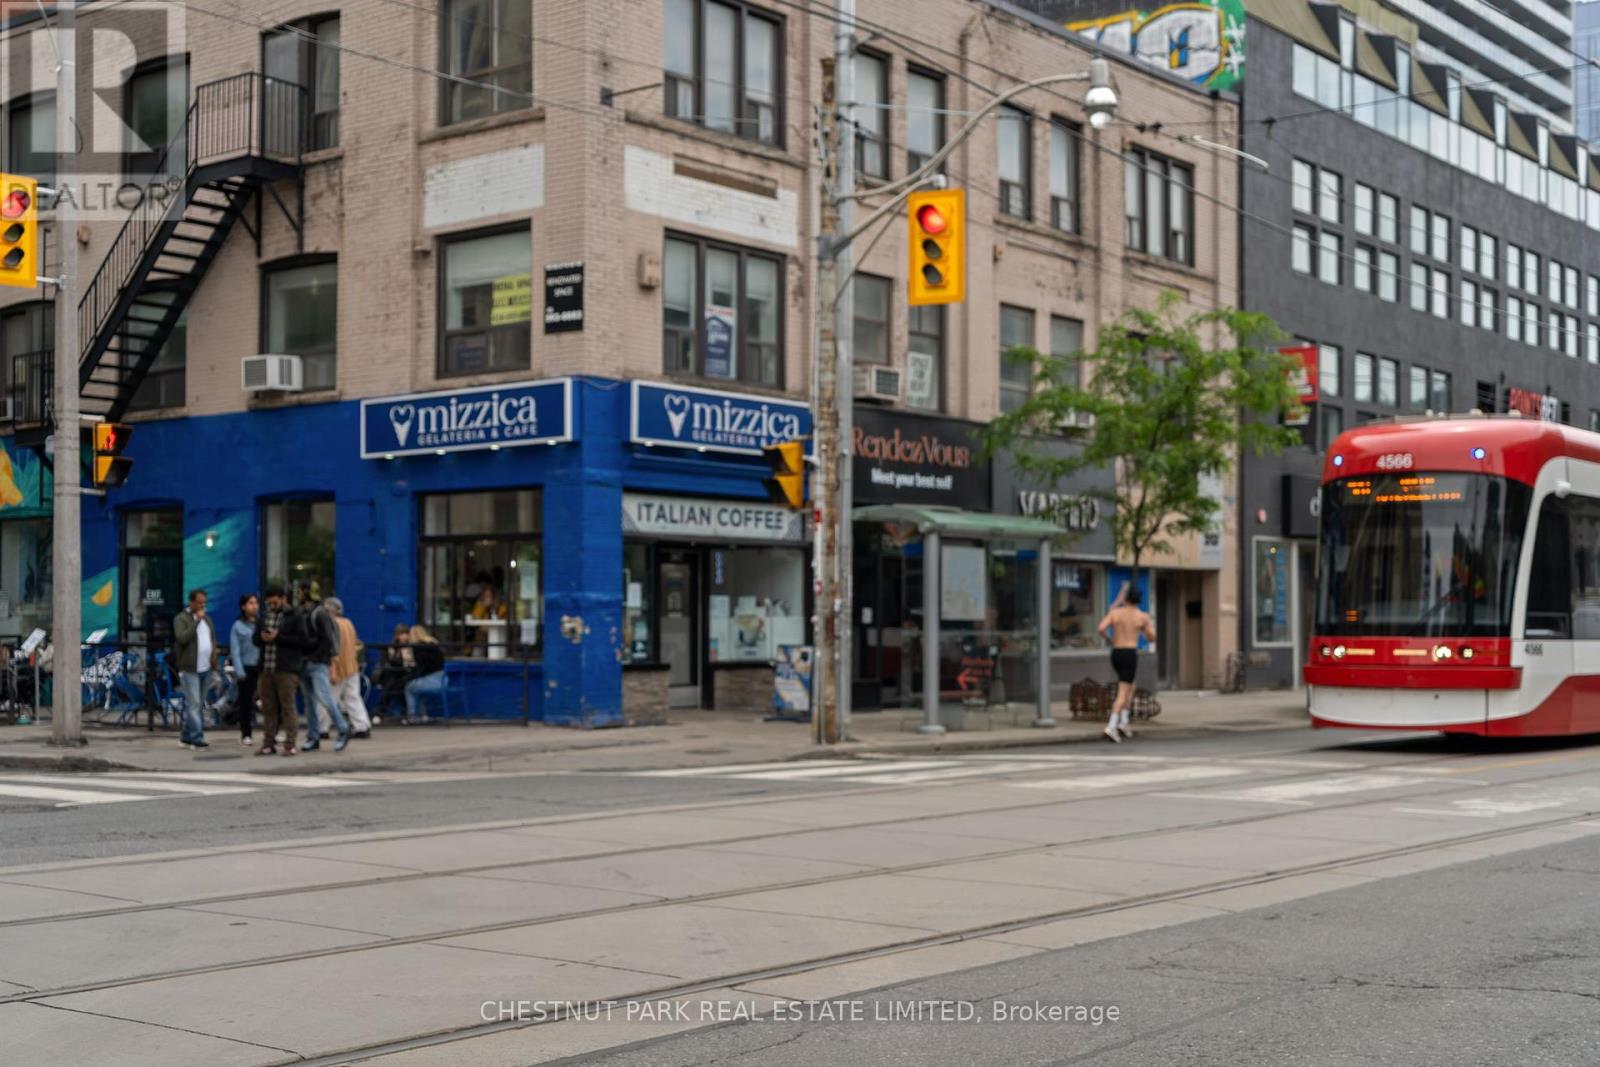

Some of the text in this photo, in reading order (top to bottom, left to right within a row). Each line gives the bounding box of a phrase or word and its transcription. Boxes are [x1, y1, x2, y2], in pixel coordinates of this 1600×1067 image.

[417, 393, 538, 433] mizzica
[692, 400, 800, 440] mizzica
[417, 429, 486, 447] GELATERIA
[490, 427, 500, 440] &
[692, 430, 756, 447] GELATERIA
[871, 467, 953, 491] Meet your best self
[637, 503, 783, 530] ITALIAN COFFEE
